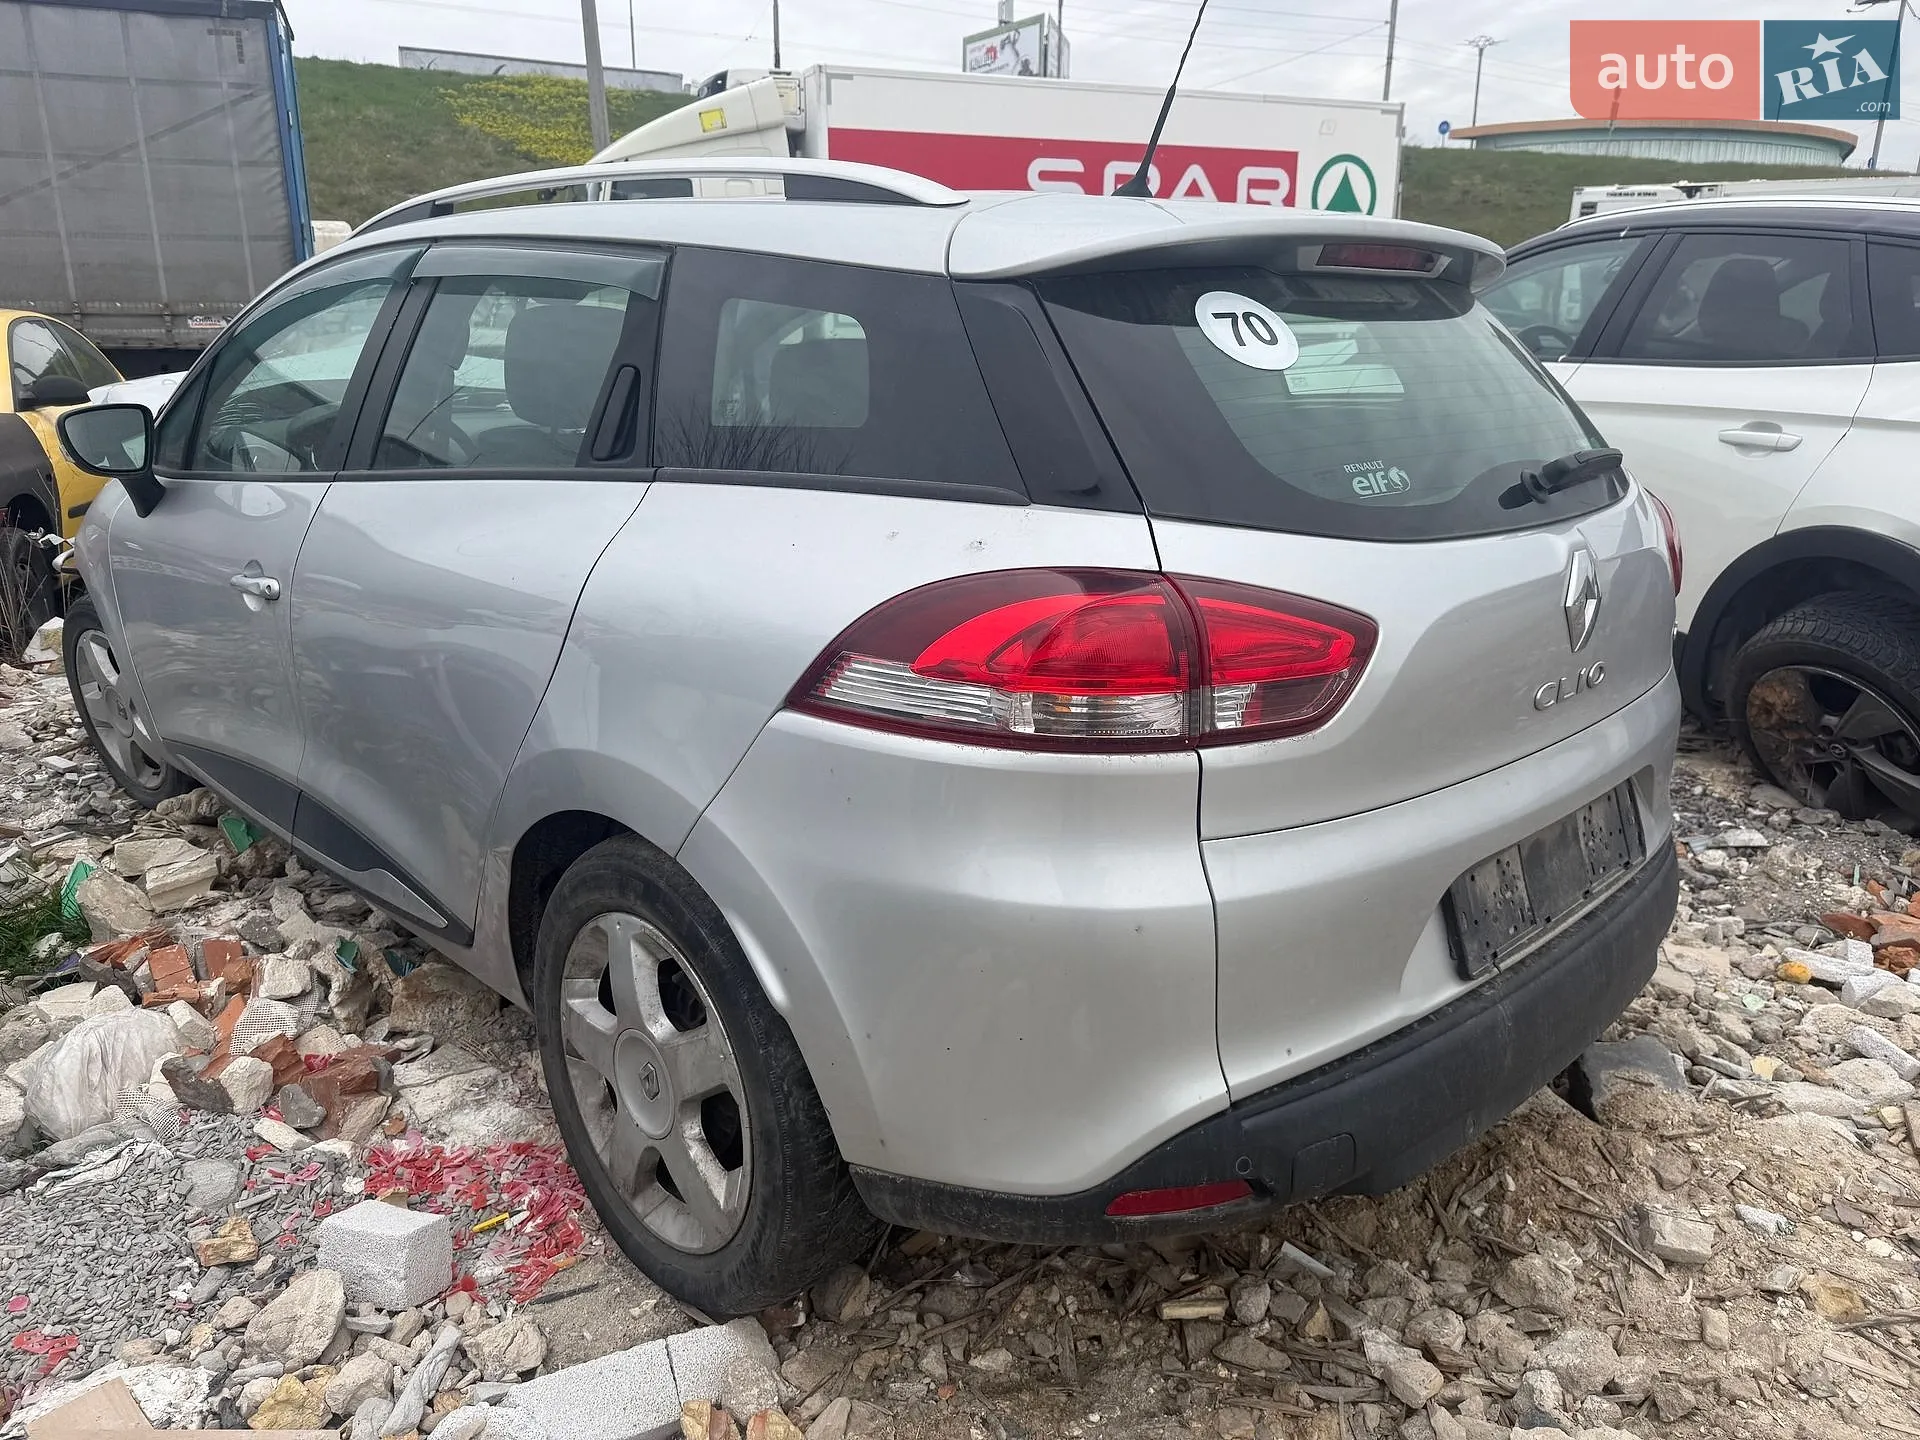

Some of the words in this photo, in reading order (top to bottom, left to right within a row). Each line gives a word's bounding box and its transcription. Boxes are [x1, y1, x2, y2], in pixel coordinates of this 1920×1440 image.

[1210, 311, 1279, 347] 70
[1343, 460, 1385, 474] RENAULT
[1352, 471, 1388, 495] elf
[1533, 660, 1606, 711] CLIO
